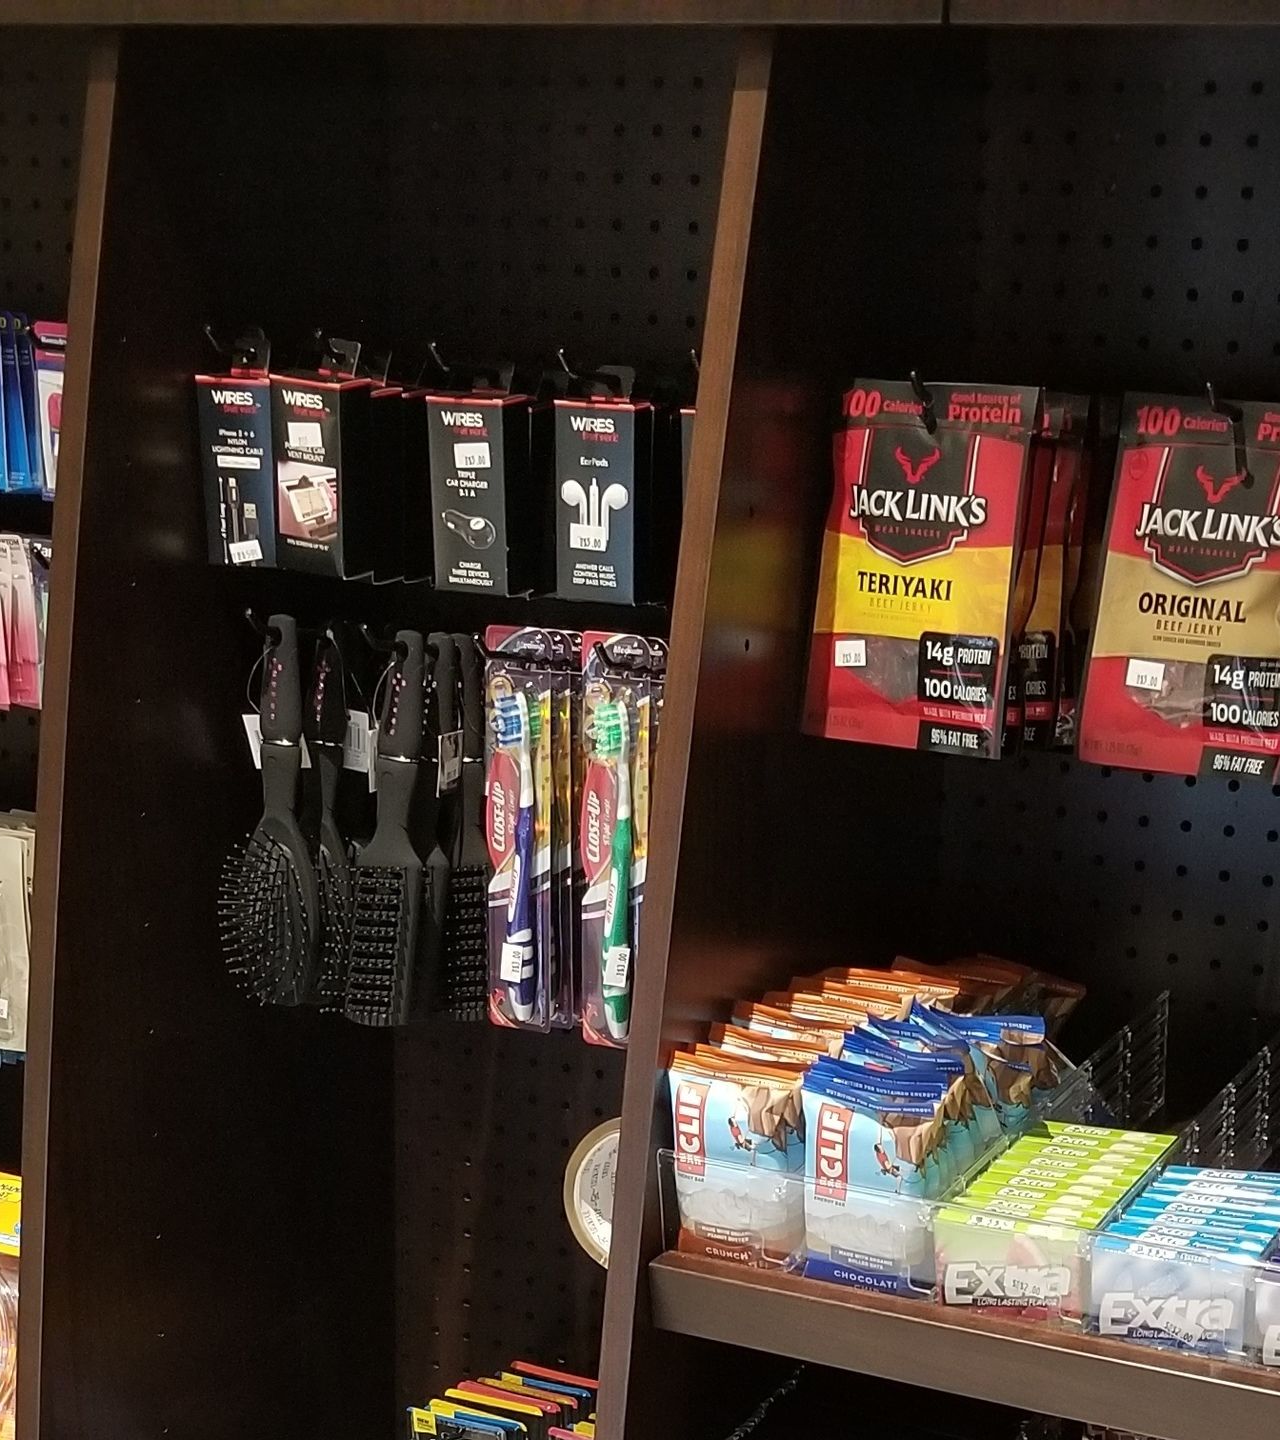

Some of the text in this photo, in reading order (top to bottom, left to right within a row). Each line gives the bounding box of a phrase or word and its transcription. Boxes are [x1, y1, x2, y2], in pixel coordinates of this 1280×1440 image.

[211, 390, 253, 405] WIRES
[282, 389, 323, 409] WIRES
[883, 401, 923, 414] Calories
[441, 411, 483, 427] WIRES
[570, 416, 614, 432] WIRES
[948, 404, 1021, 424] Protein
[1136, 406, 1228, 435] 100 Calories
[850, 484, 987, 527] JACK LINK'S
[1136, 504, 1199, 541] JACK
[857, 570, 953, 601] TERIYAKI
[1138, 592, 1246, 623] ORIGINAL
[1156, 619, 1222, 636] BEEF JERKY
[925, 641, 992, 666] 14g PROTEIN
[1213, 664, 1244, 688] 14g
[924, 678, 987, 702] 100 CALORIES
[1210, 702, 1279, 727] 100 CALORIES
[931, 728, 979, 749] 96% FAT FREE
[1212, 754, 1265, 775] 96% FAT FREE
[492, 780, 507, 853] CLOSE-UP
[586, 790, 600, 863] CLOSE-UP
[678, 1083, 703, 1152] CLIF
[1063, 1125, 1112, 1136] Extra
[823, 1110, 849, 1179] CLIF
[1196, 1170, 1249, 1180] Extra
[946, 1263, 1071, 1305] Extra
[977, 1297, 997, 1307] LONG
[1099, 1292, 1234, 1335] Extra
